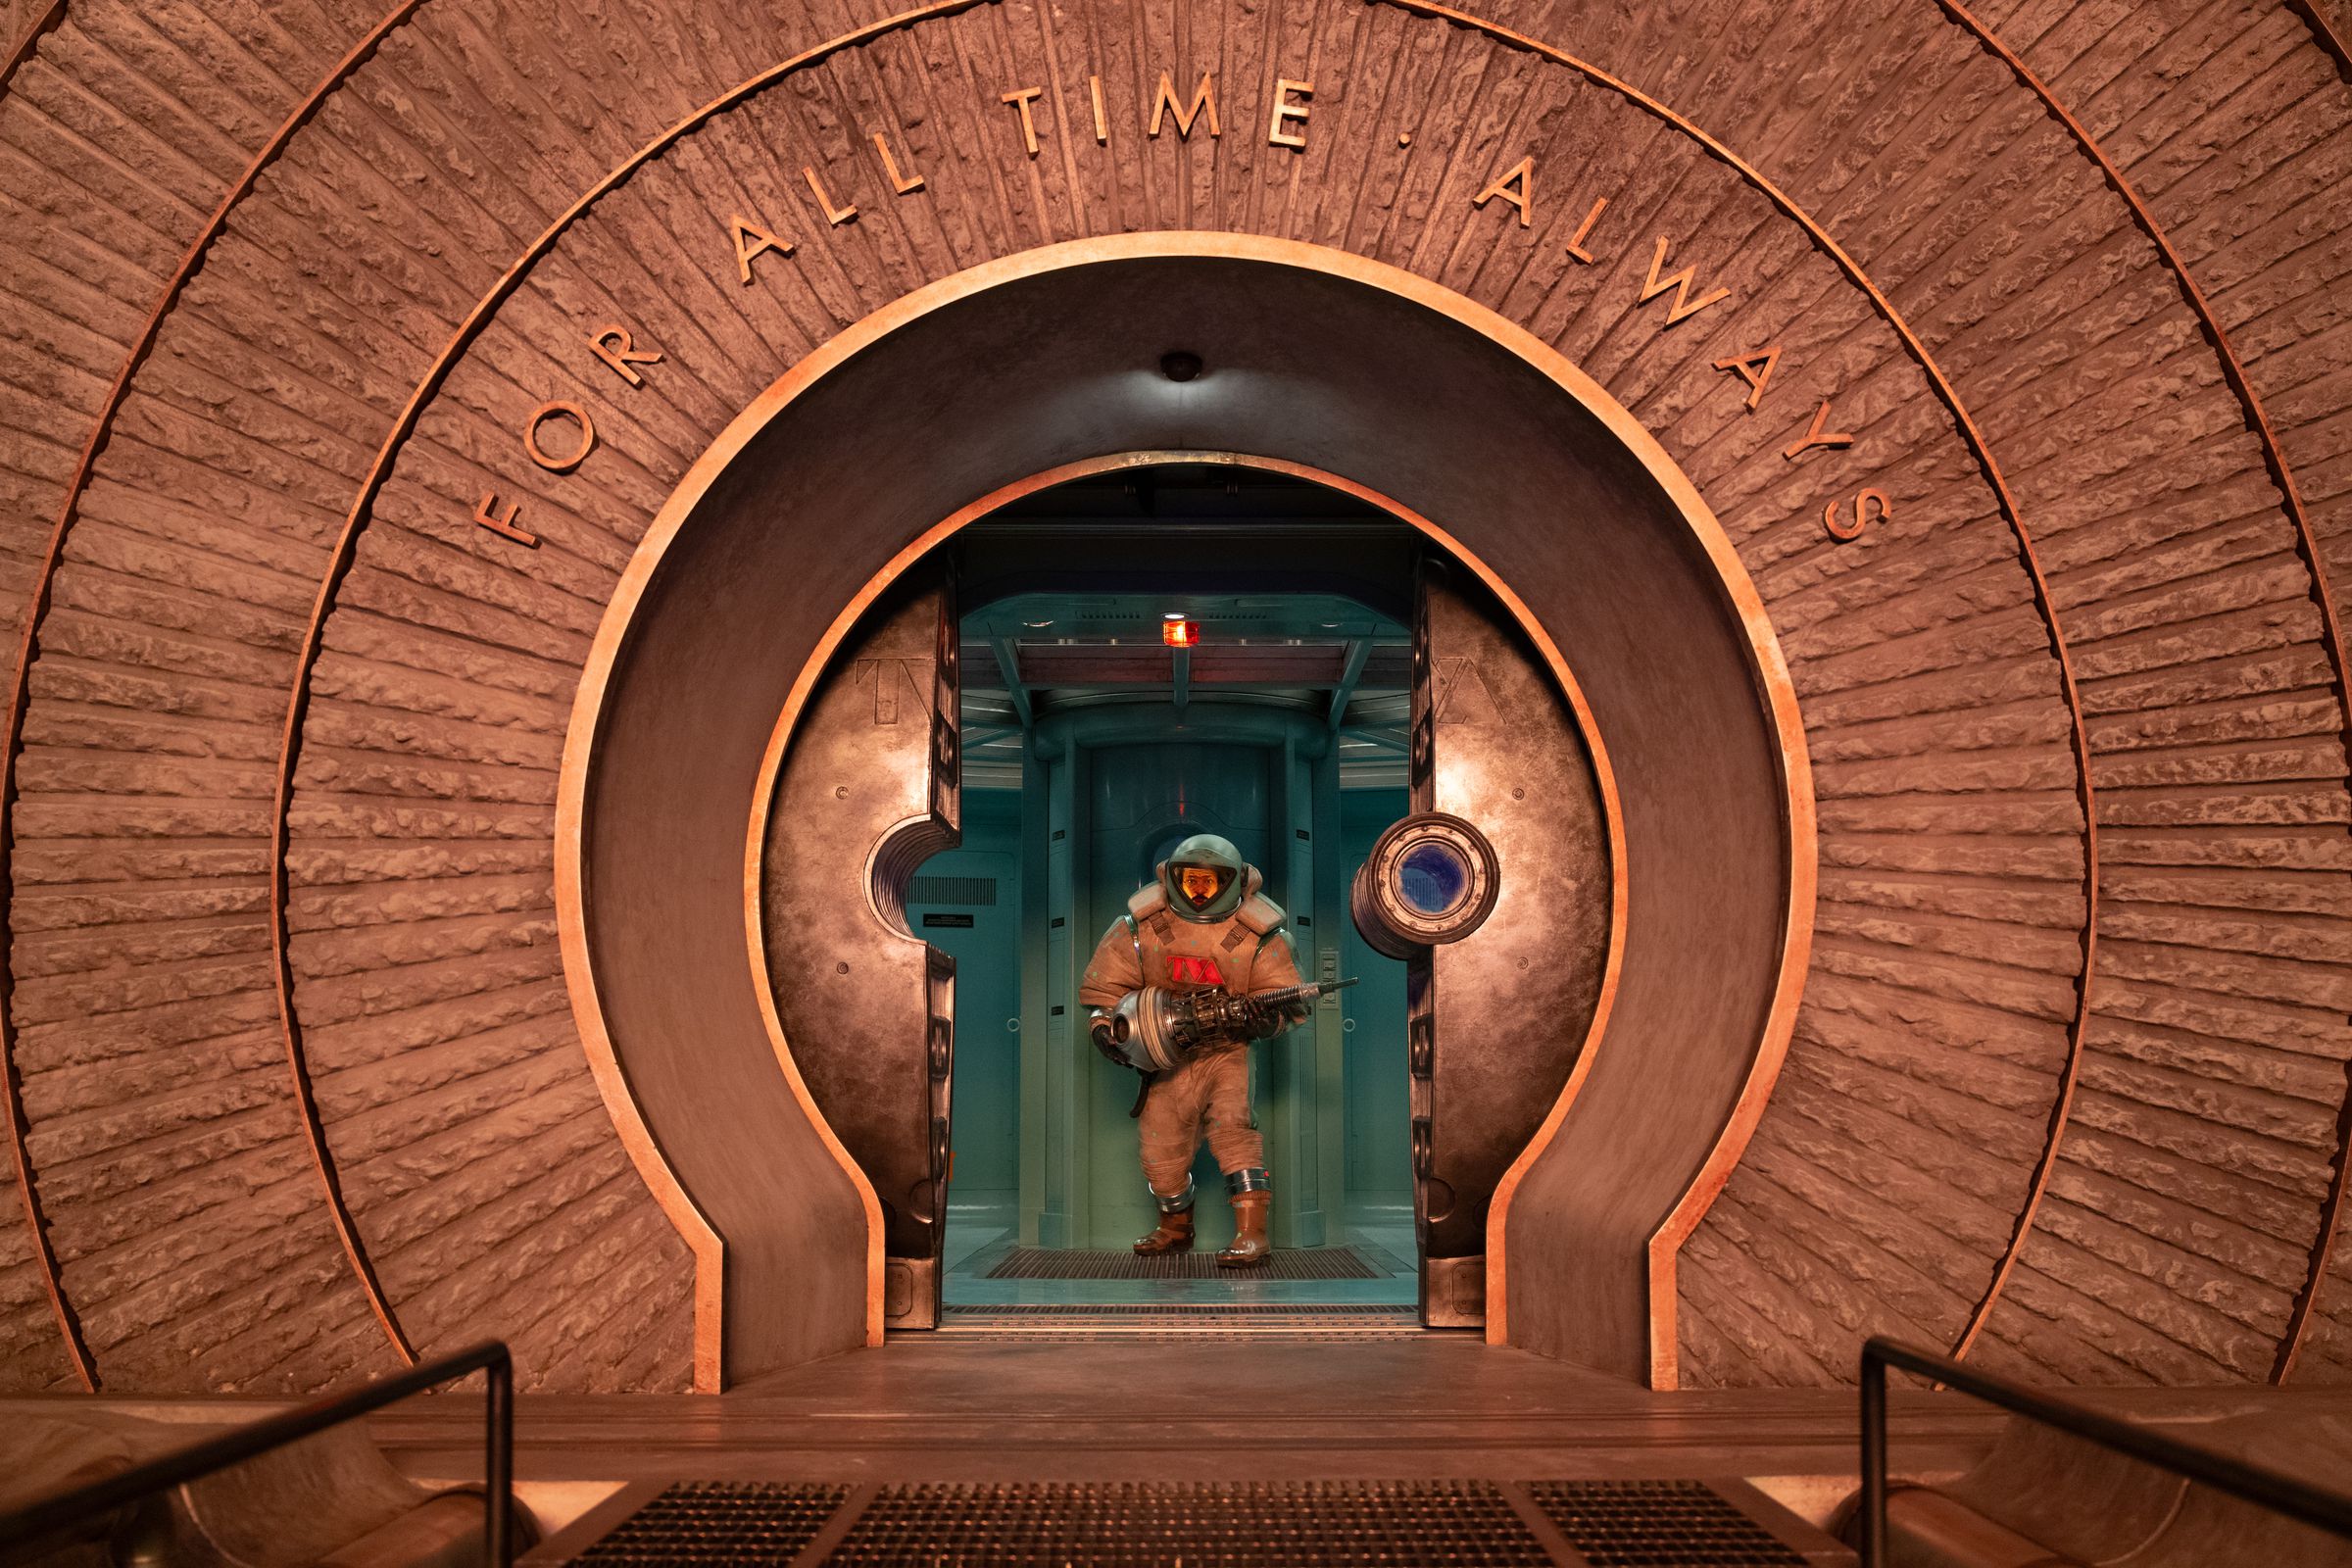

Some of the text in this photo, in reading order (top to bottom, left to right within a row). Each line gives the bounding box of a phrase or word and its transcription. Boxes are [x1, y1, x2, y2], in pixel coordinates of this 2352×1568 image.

[473, 324, 663, 546] FOR
[731, 131, 925, 284] ALL
[1002, 72, 1314, 155] TIME
[1472, 156, 1891, 540] ALWAYS
[1166, 956, 1224, 985] TVA
